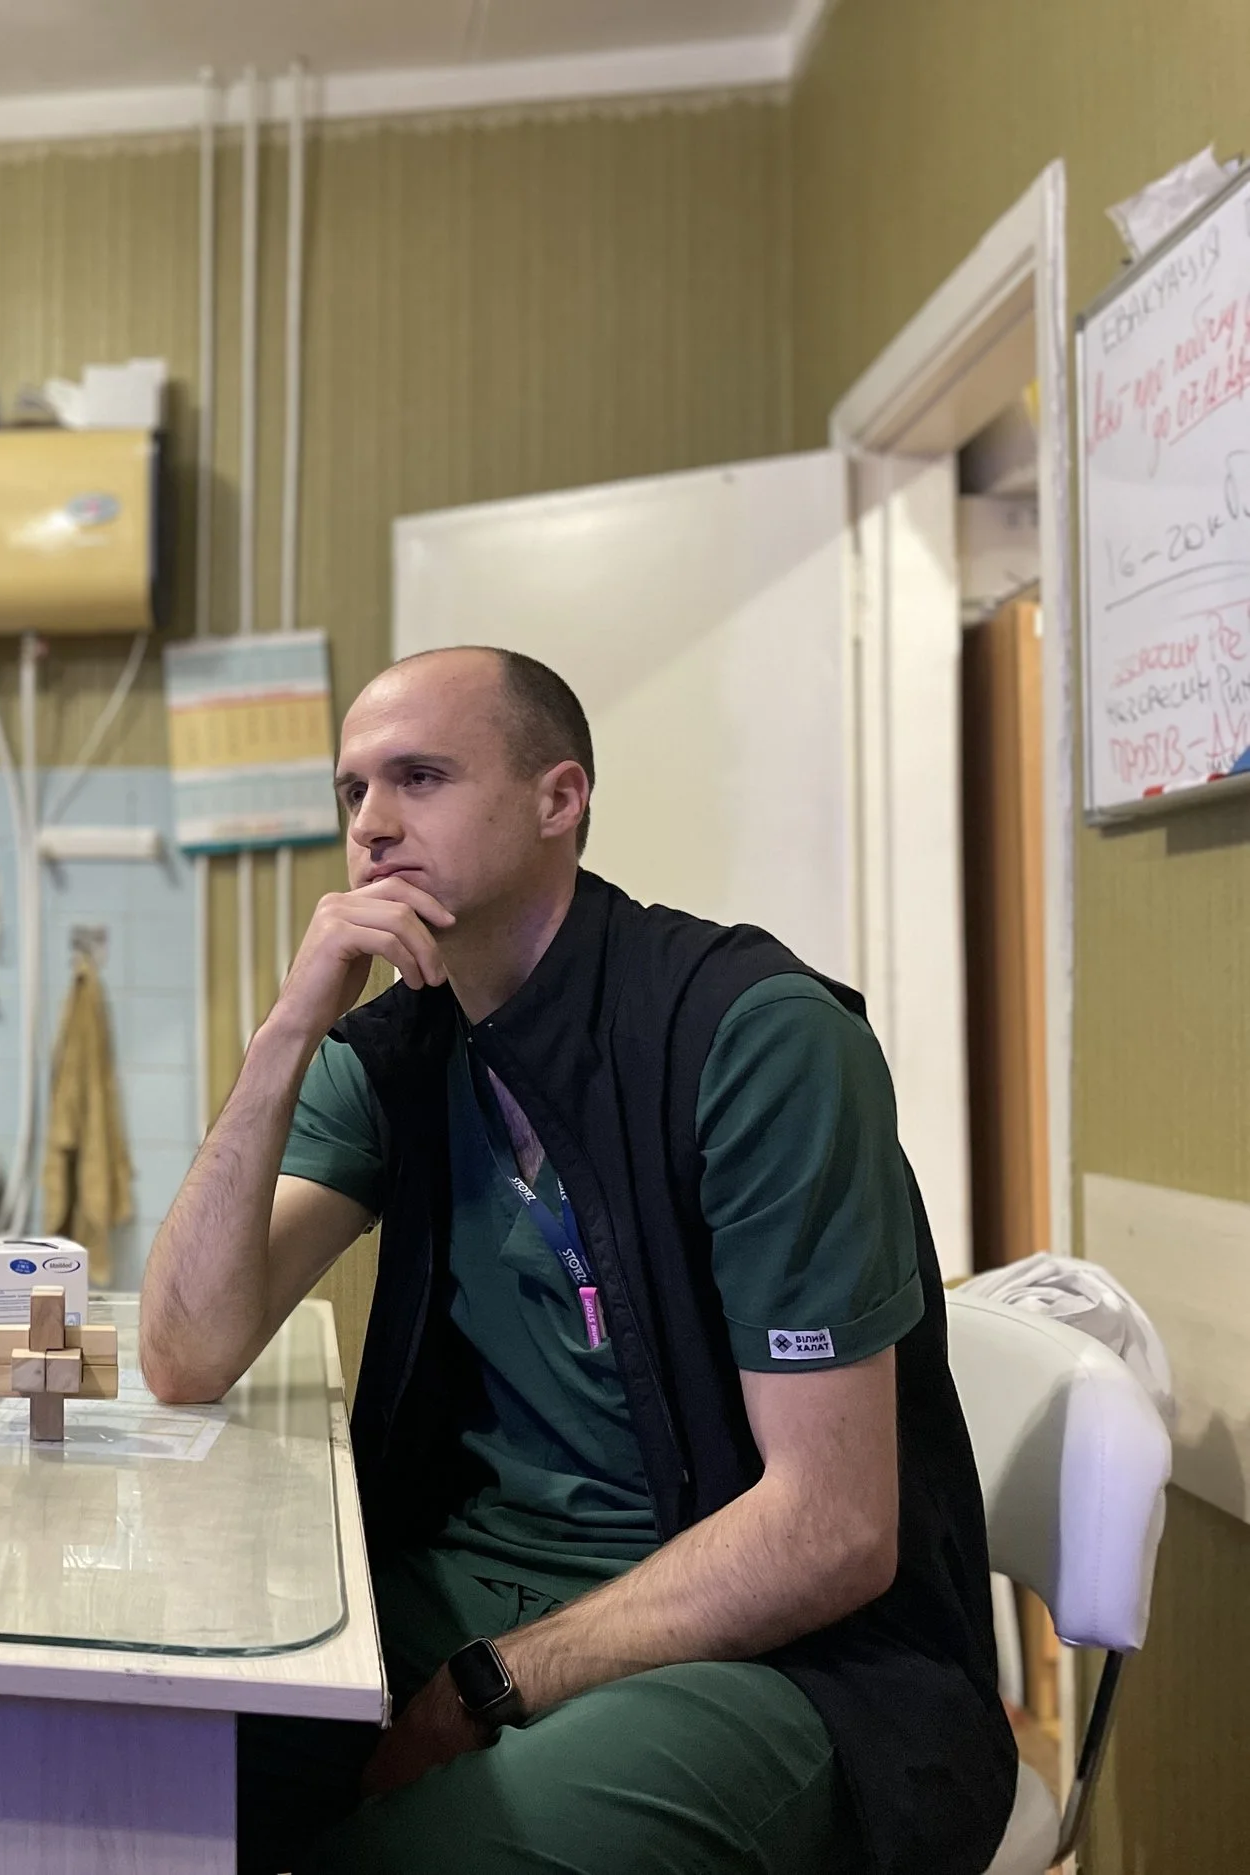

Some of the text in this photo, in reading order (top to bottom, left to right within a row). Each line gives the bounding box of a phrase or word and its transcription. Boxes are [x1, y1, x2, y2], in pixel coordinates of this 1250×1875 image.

[511, 1177, 537, 1201] STORZ
[562, 1248, 587, 1281] STORZ
[796, 1333, 826, 1343] БІЛИЙ
[797, 1343, 829, 1352] ХАЛАТ
